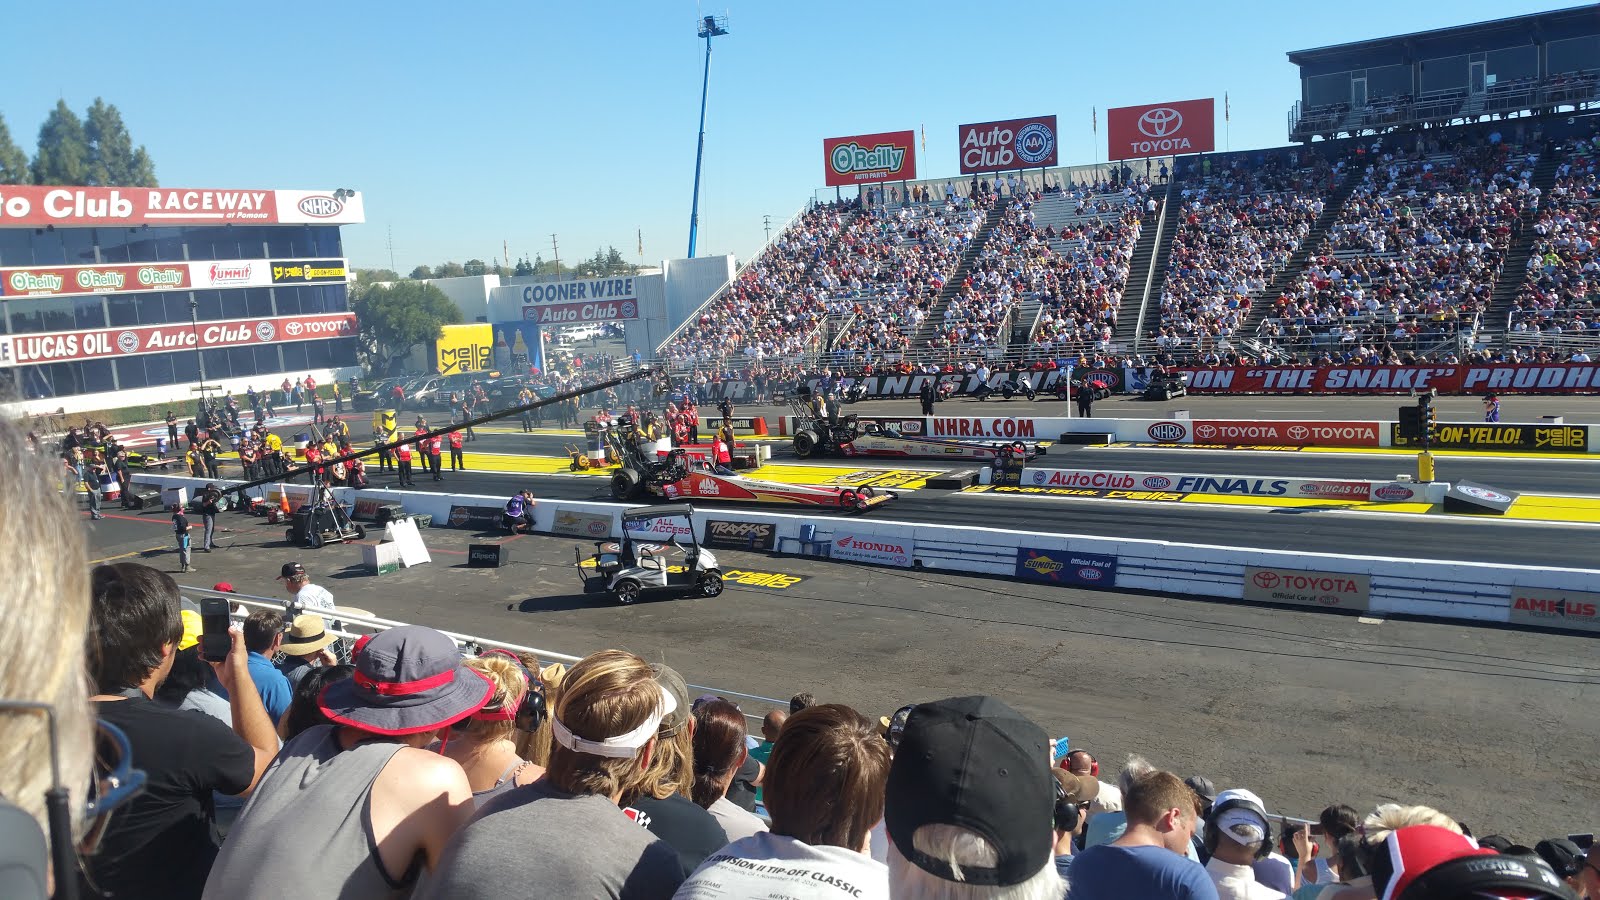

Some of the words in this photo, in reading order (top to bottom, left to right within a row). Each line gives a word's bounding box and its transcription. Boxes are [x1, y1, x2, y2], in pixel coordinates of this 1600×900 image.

[962, 126, 1014, 149] Auto
[1025, 136, 1044, 148] AAA
[1131, 137, 1191, 154] TOYOTA
[831, 144, 906, 174] O'Reilly
[963, 146, 1014, 168] Club
[869, 171, 887, 179] PARTS
[44, 189, 133, 219] Club
[148, 191, 266, 211] RACEWAY
[302, 198, 339, 215] NHRA
[237, 210, 269, 219] Pomona
[12, 272, 62, 291] O'Reilly
[78, 269, 124, 289] O'Reilly
[139, 267, 182, 286] O'Reilly
[523, 284, 587, 303] COONER
[589, 278, 633, 298] WIRE
[541, 307, 578, 322] Auto
[581, 303, 618, 319] Club
[304, 320, 351, 333] TOYOTA
[146, 330, 199, 349] Auto
[203, 324, 252, 343] Club
[17, 334, 78, 361] LUCAS
[83, 332, 113, 355] OIL
[884, 422, 901, 431] FOX
[933, 418, 1036, 438] NHRA.COM
[1153, 425, 1181, 439] NHRA
[1219, 426, 1278, 438] TOYOTA
[1311, 427, 1376, 439] TOYOTA
[699, 477, 718, 490] MAC
[1144, 477, 1169, 489] NHRA
[1176, 476, 1289, 496] FINALS
[1320, 484, 1352, 493] LUCAS
[1353, 486, 1369, 494] OIL
[656, 517, 674, 526] ALL
[711, 521, 771, 536] TRAXXAS
[652, 525, 691, 535] ACCESS
[852, 540, 905, 554] HONDA
[471, 552, 497, 560] Klipsch
[1070, 558, 1091, 566] Official
[1026, 559, 1062, 571] SUNOCO
[1081, 568, 1099, 579] NHRA
[1282, 575, 1359, 594] TOYOTA
[1272, 592, 1295, 600] Official
[713, 854, 758, 870] DIVISION
[756, 864, 767, 872] II
[767, 866, 810, 877] TIP-OFF
[811, 872, 862, 899] CLASSIC
[702, 880, 722, 889] TEAMS
